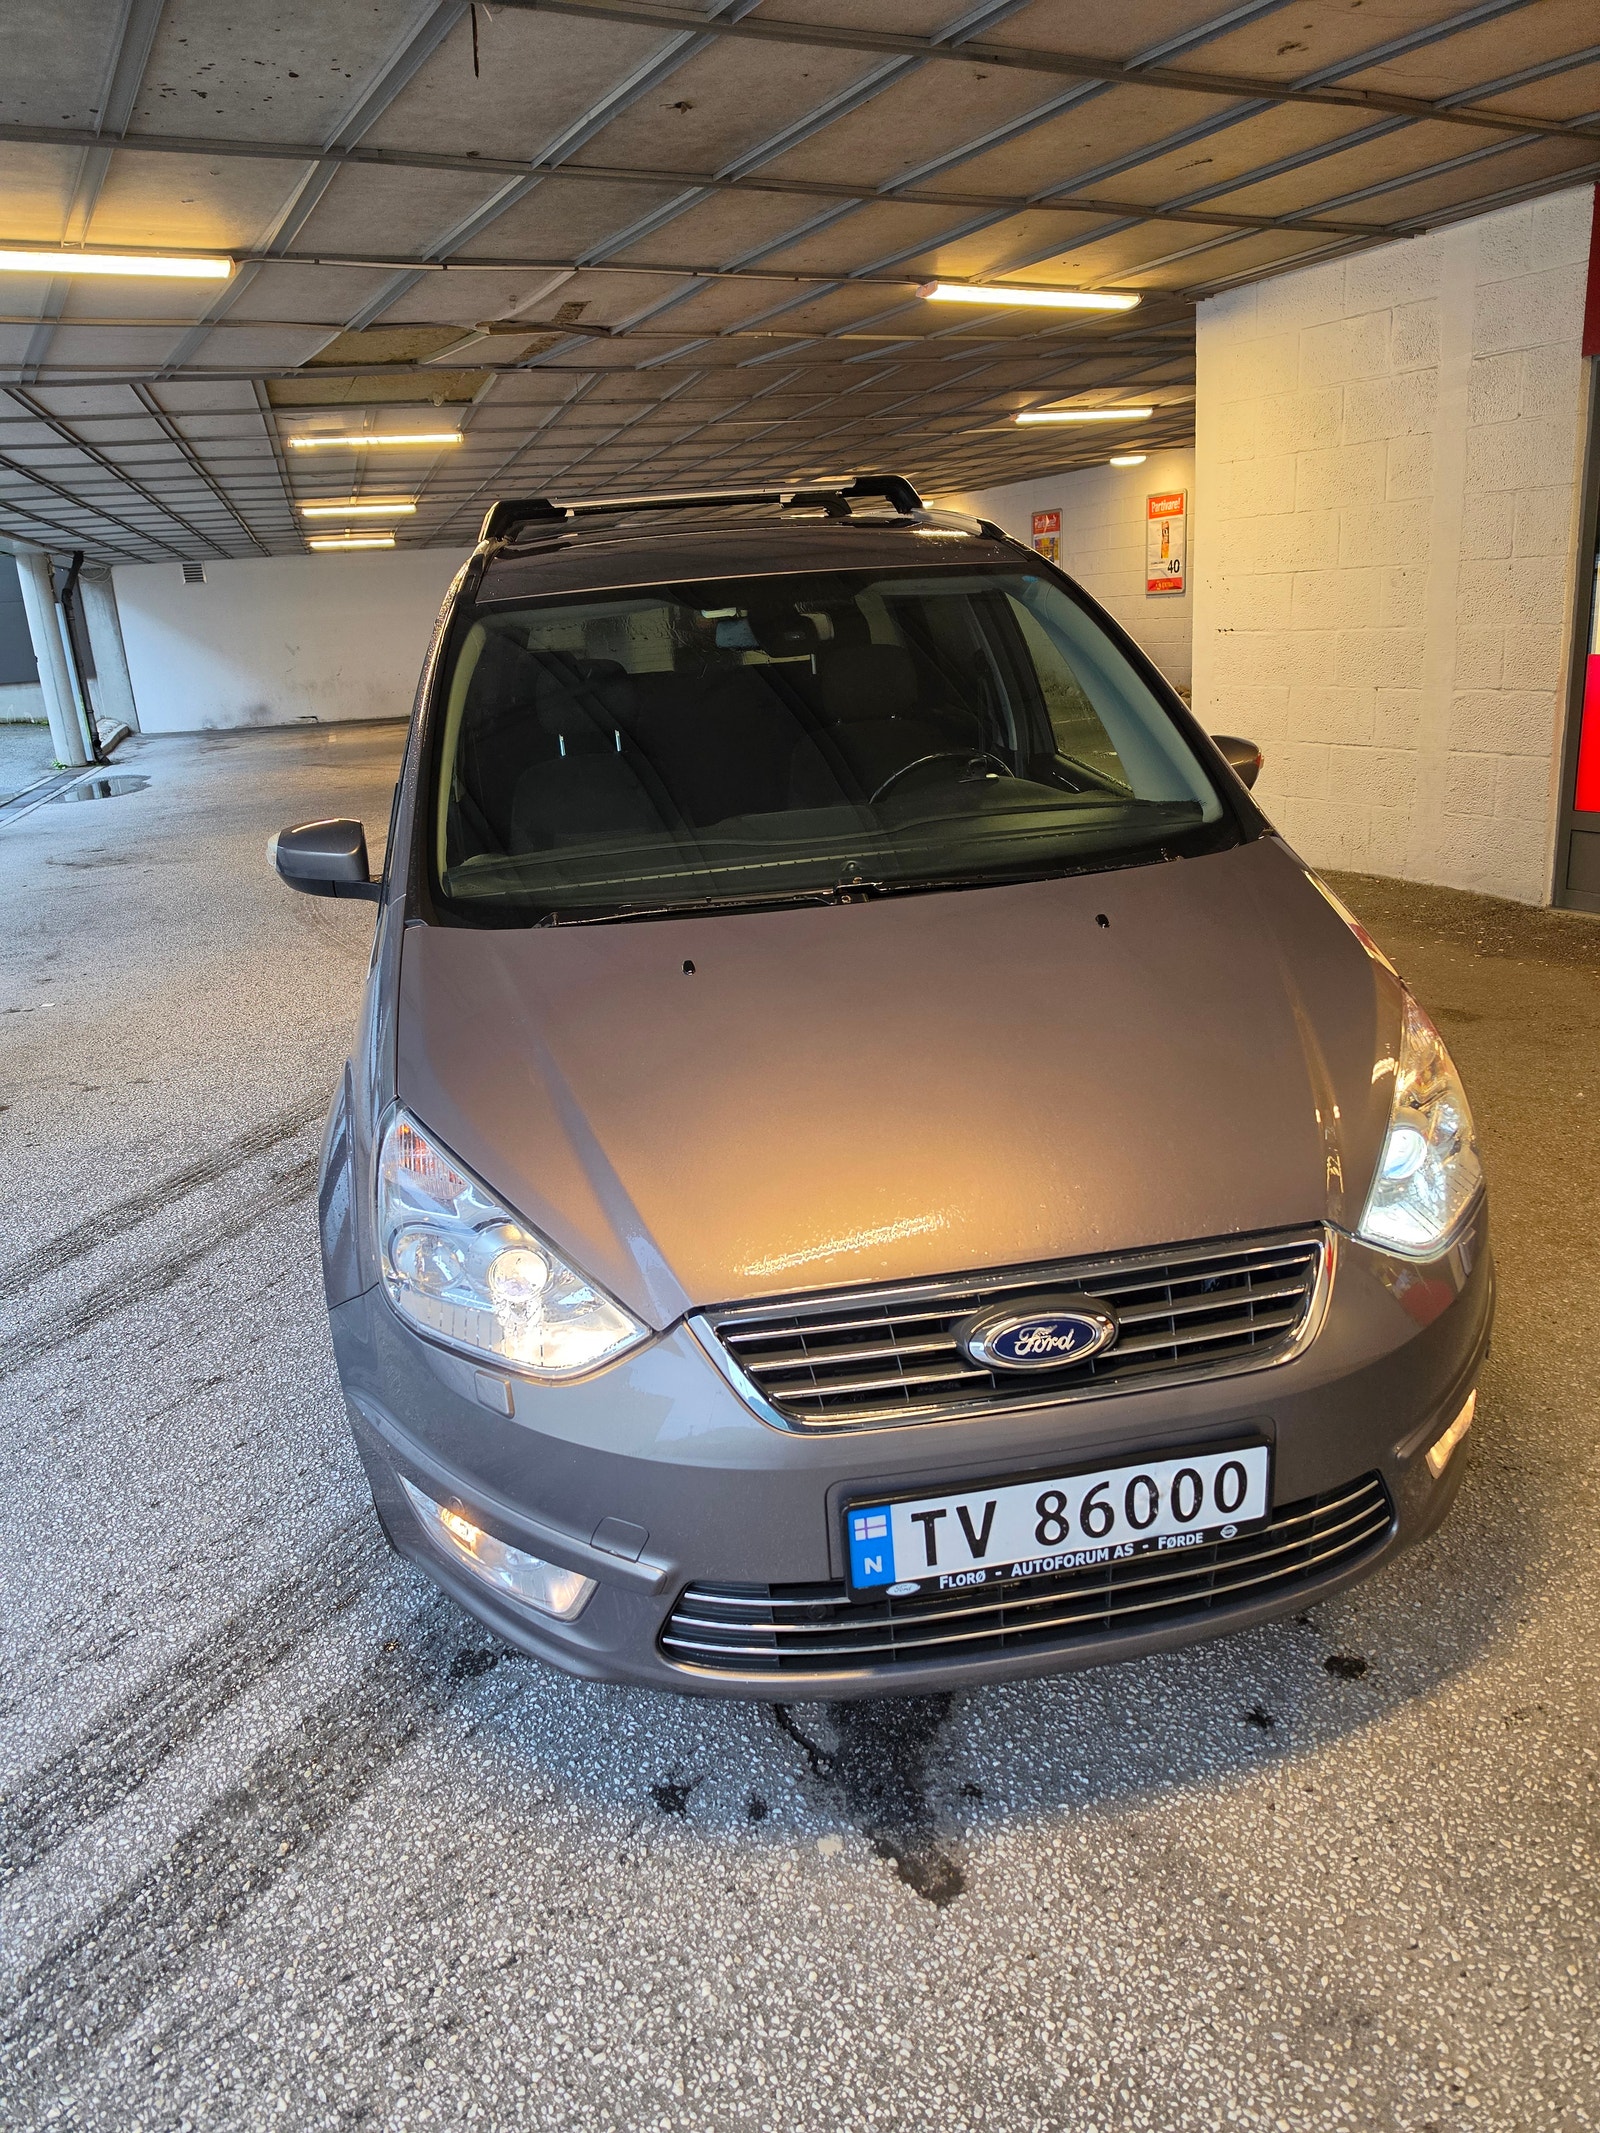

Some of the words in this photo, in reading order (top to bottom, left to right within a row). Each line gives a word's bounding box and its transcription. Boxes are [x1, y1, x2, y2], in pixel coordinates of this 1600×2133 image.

[1151, 497, 1181, 513] Partivare!
[1167, 559, 1180, 573] 40
[1014, 1325, 1075, 1356] Ford
[911, 1500, 997, 1567] TV
[1035, 1460, 1247, 1546] 86000
[864, 1555, 882, 1575] N
[1011, 1548, 1109, 1577] AUTOFORUM
[1113, 1543, 1134, 1560] AS
